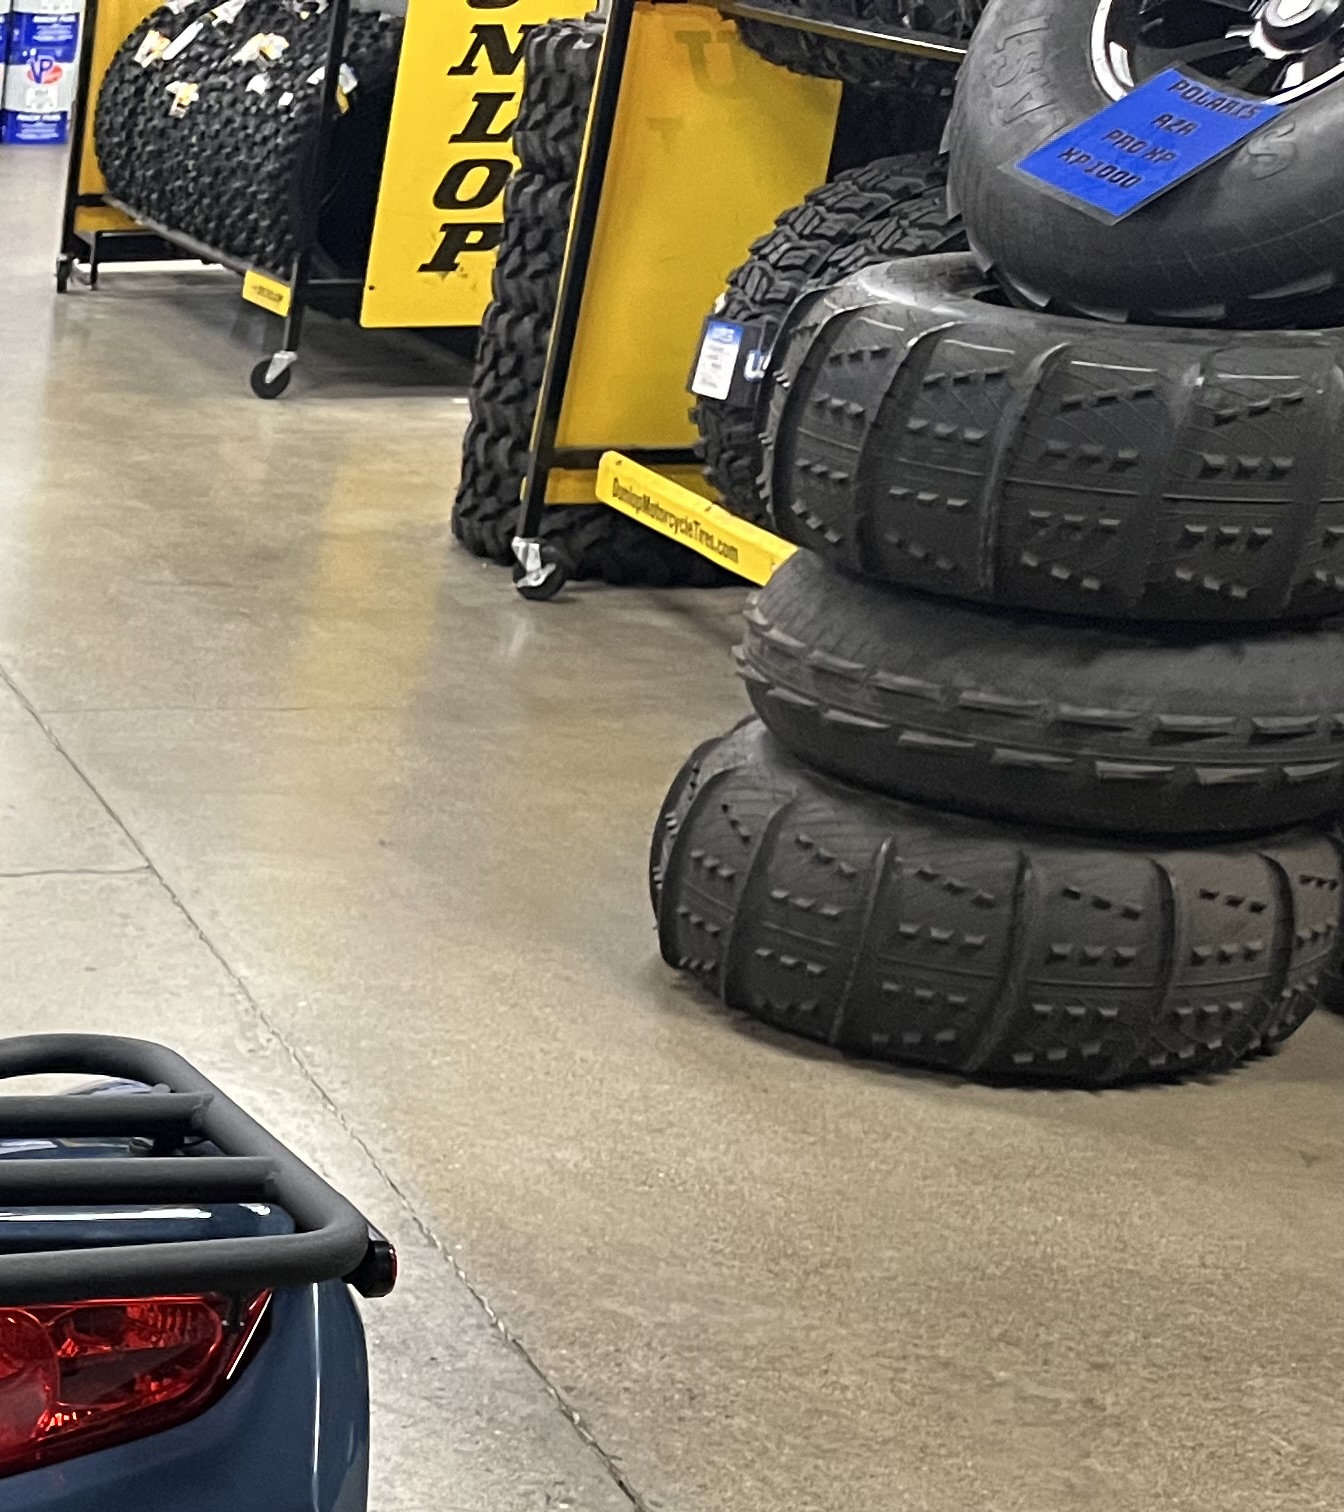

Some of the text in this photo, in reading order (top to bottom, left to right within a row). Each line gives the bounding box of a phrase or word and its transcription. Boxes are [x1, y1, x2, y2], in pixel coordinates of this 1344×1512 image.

[28, 57, 54, 84] VP
[1167, 79, 1262, 120] POLARIS
[416, 0, 542, 272] NLOP
